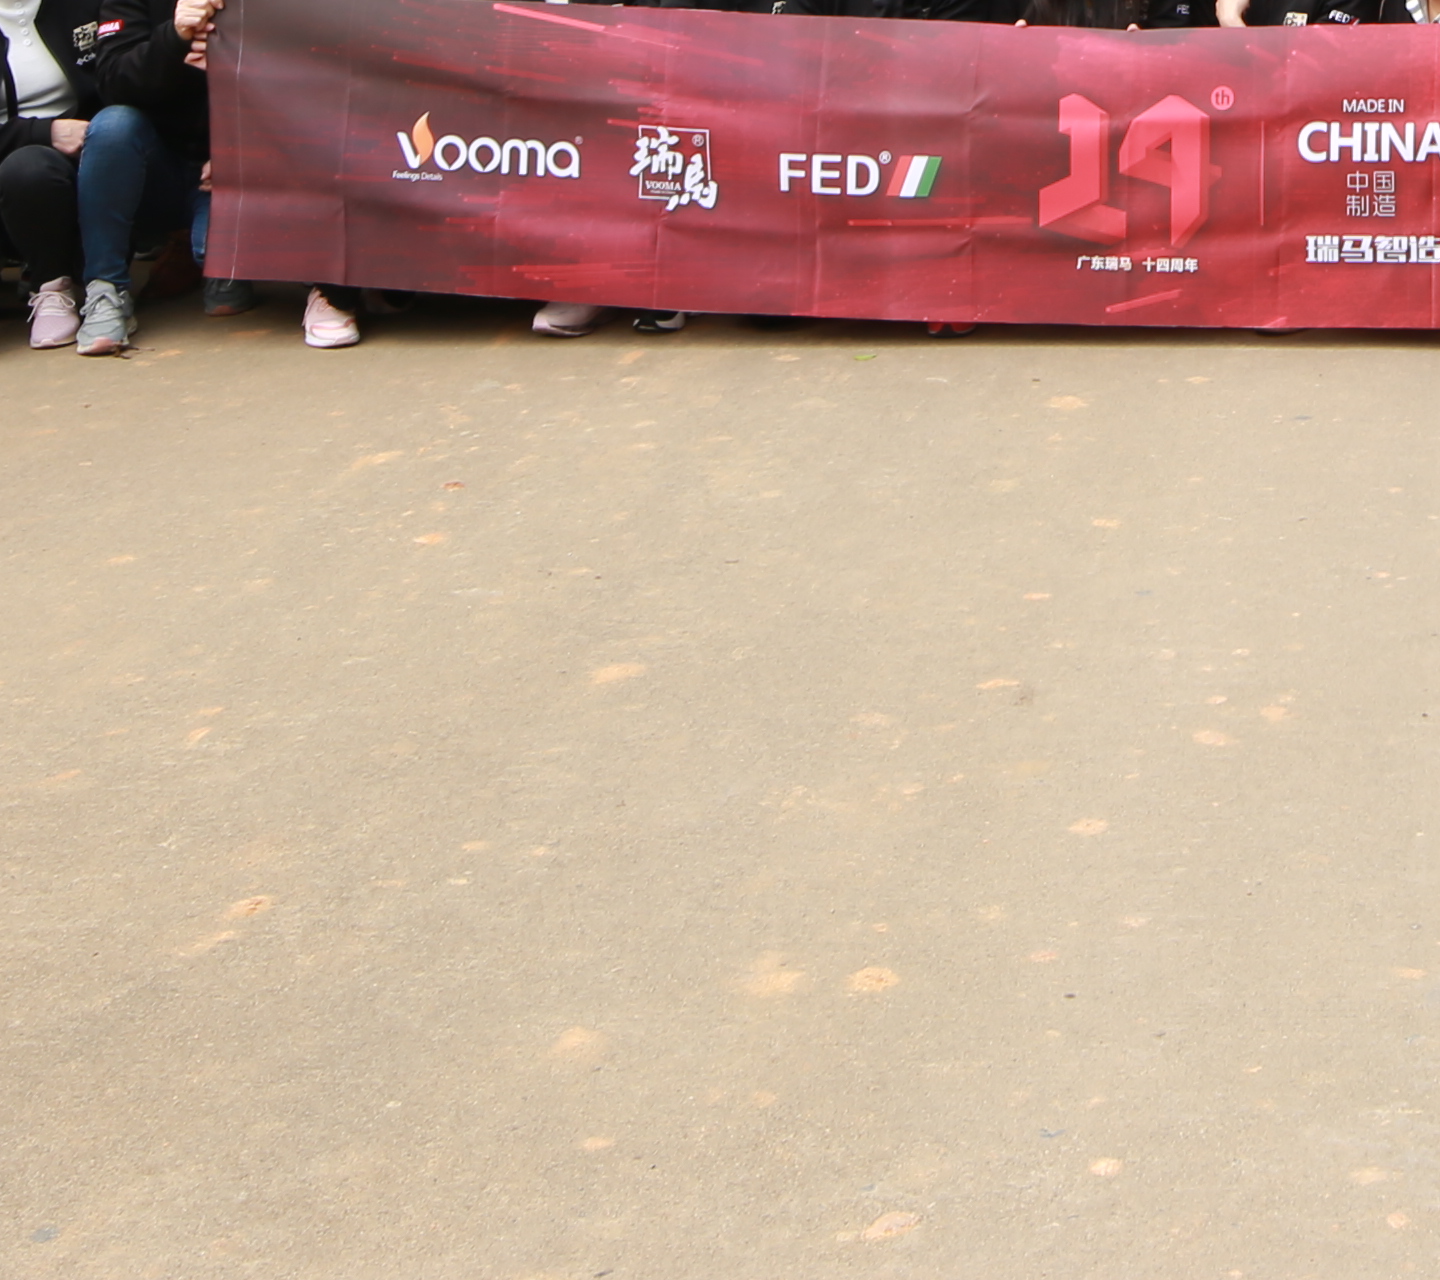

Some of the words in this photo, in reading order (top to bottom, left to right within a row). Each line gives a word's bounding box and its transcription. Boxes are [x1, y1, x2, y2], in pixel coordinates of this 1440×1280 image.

[1342, 98, 1386, 113] MADE
[1388, 98, 1405, 113] IN
[645, 180, 682, 191] VOOMA
[1346, 170, 1396, 193] 中国
[1346, 194, 1397, 217] 制造
[1142, 257, 1199, 273] 十四周年
